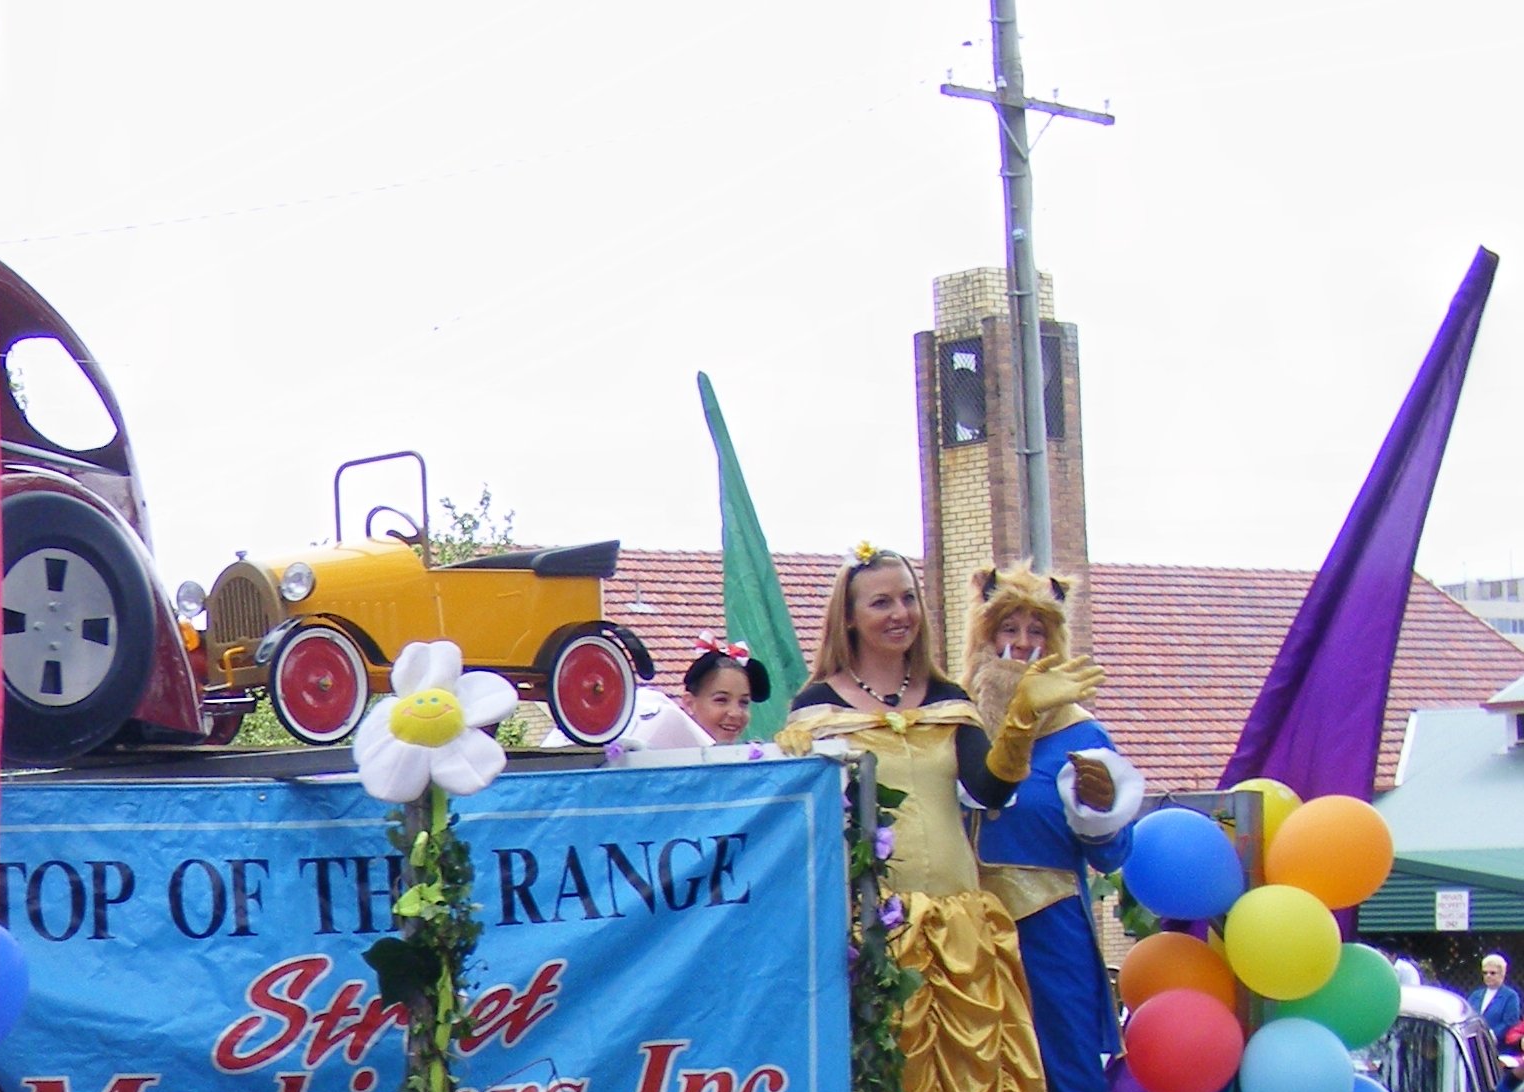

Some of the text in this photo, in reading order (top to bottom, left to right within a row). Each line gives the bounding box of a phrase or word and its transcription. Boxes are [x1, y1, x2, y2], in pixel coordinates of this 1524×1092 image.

[168, 859, 269, 939] OF
[299, 853, 406, 935] TH
[492, 832, 751, 927] RANGE
[214, 954, 566, 1074] Stret
